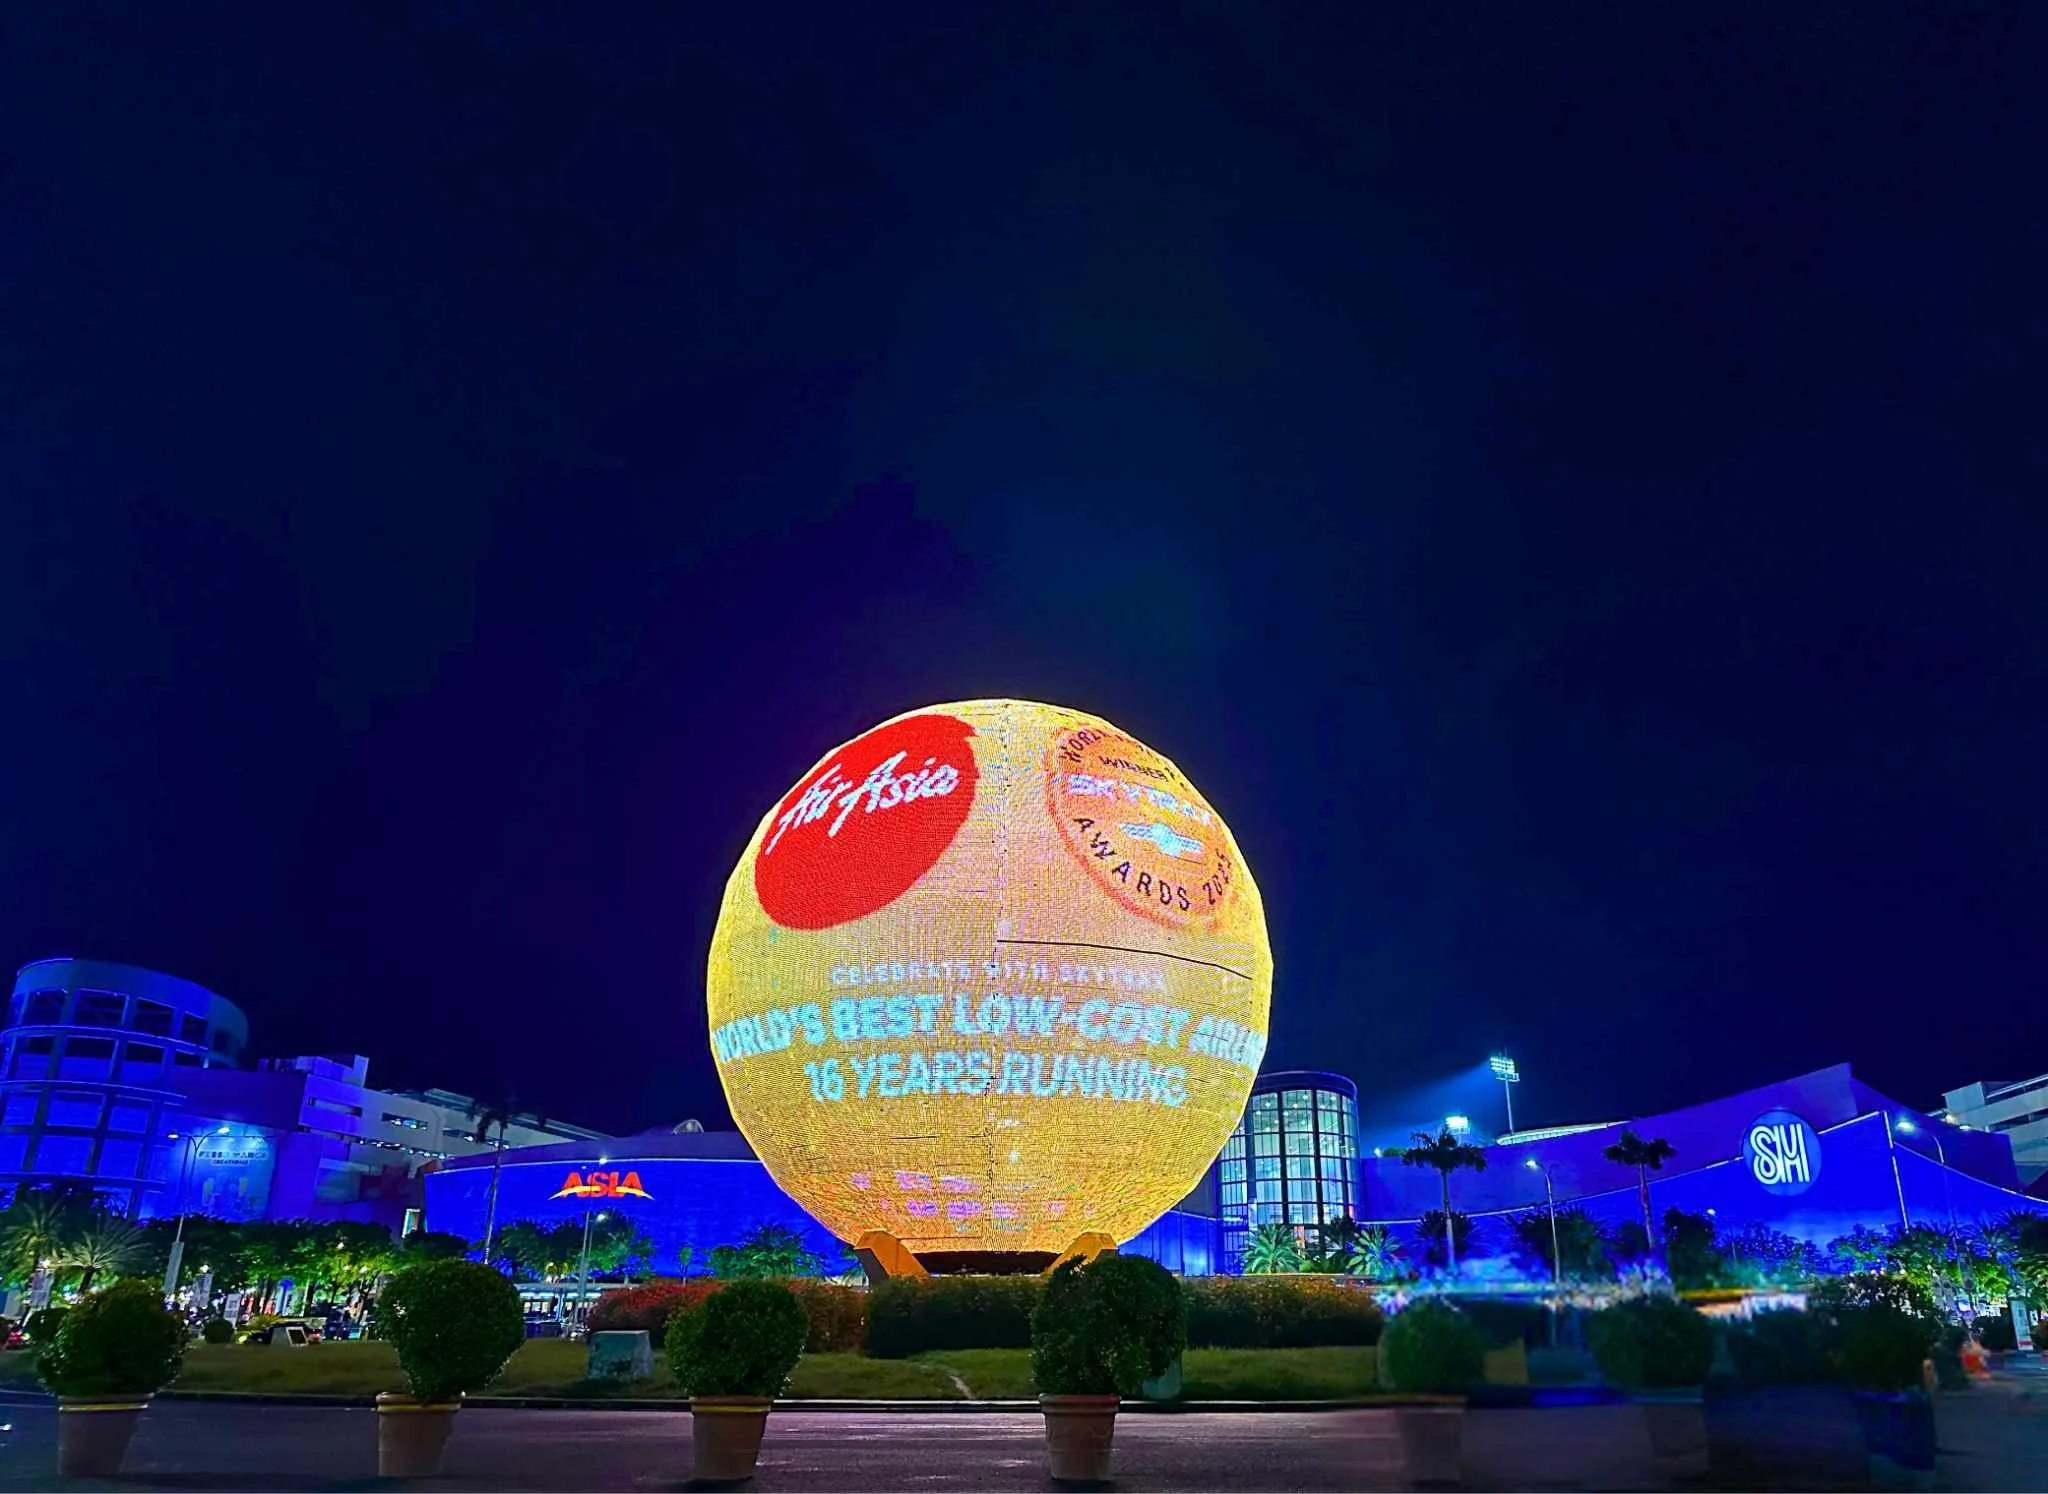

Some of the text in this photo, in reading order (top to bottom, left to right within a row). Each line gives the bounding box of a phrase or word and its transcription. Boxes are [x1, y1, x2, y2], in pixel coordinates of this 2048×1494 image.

[1073, 817, 1192, 912] AWARDS
[714, 1002, 827, 1065] WORLD'S
[829, 993, 944, 1041] BEST
[954, 991, 1191, 1050] LOW-COST
[803, 1050, 1190, 1108] 16 YEARS RUNNING
[559, 1171, 643, 1198] ASIA
[1749, 1123, 1811, 1185] SM
